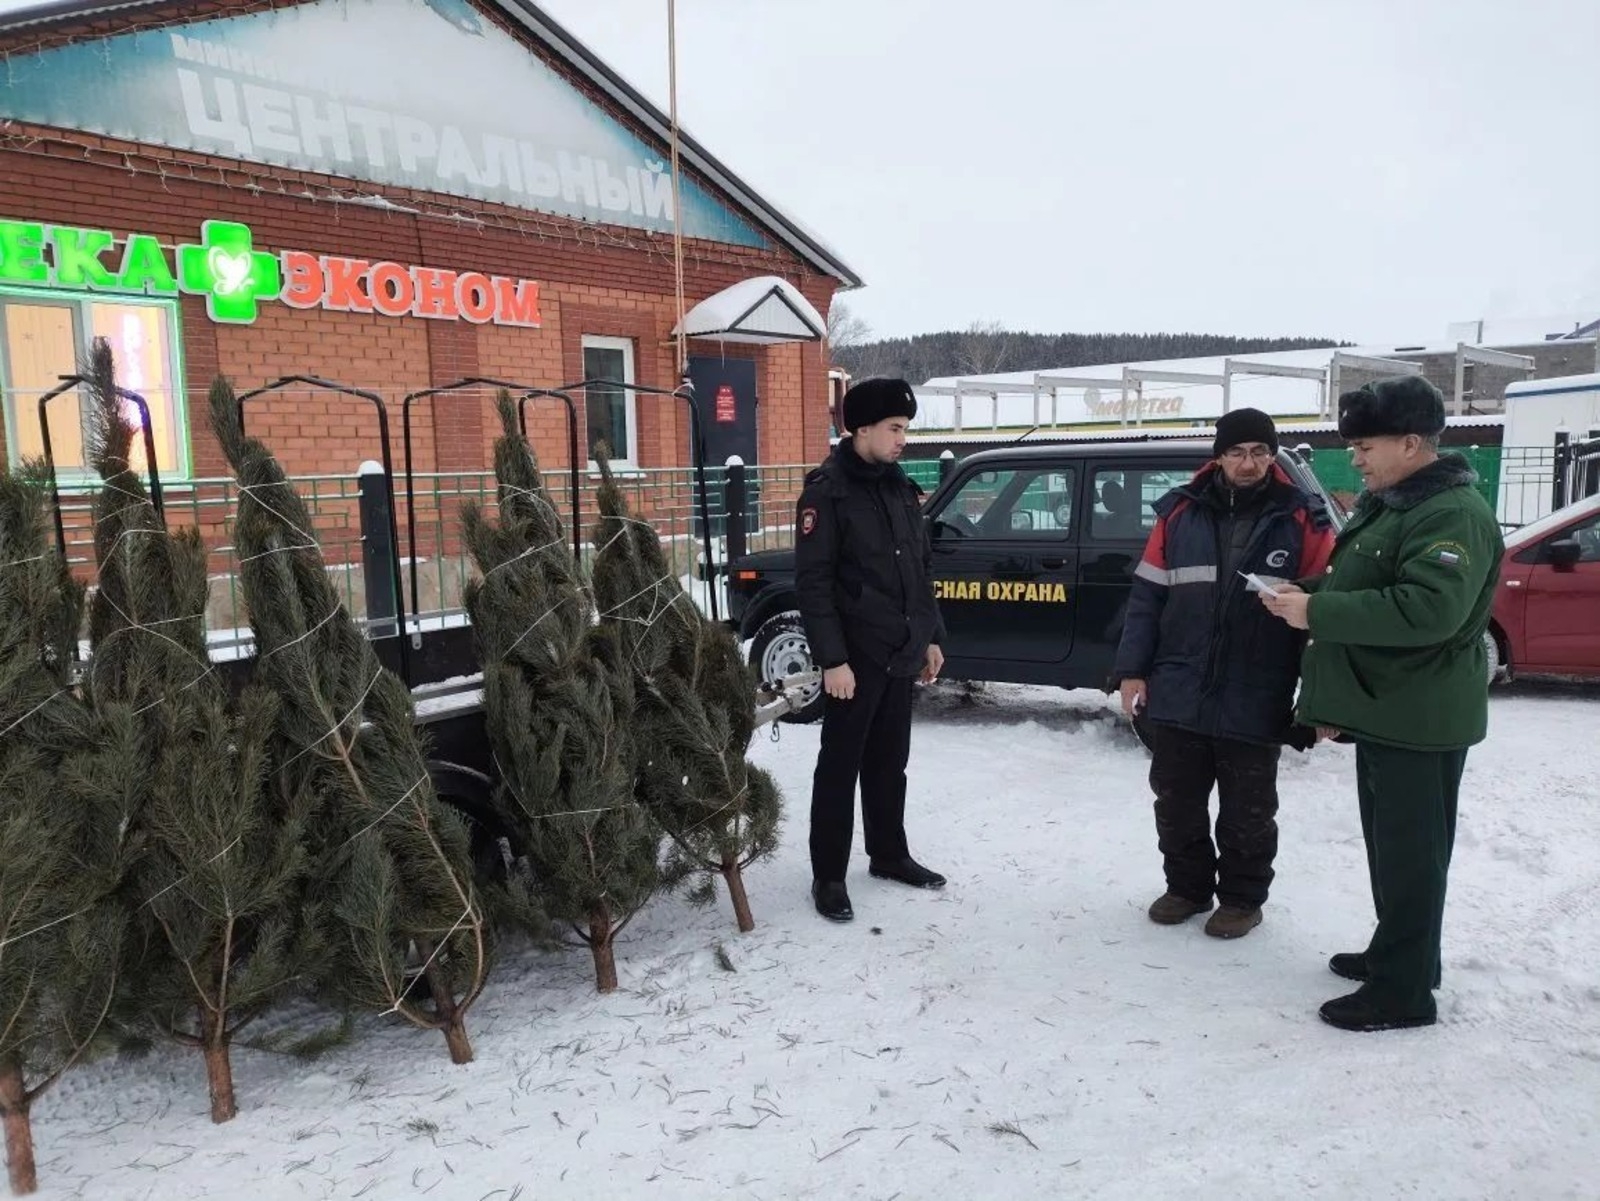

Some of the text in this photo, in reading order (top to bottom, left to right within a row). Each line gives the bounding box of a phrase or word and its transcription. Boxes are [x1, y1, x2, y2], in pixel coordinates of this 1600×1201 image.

[177, 67, 676, 221] ЦЕНТРАЛЬНЫЙ
[280, 250, 541, 328] ЭКОНОМ
[986, 581, 1067, 603] ОХРАНА
